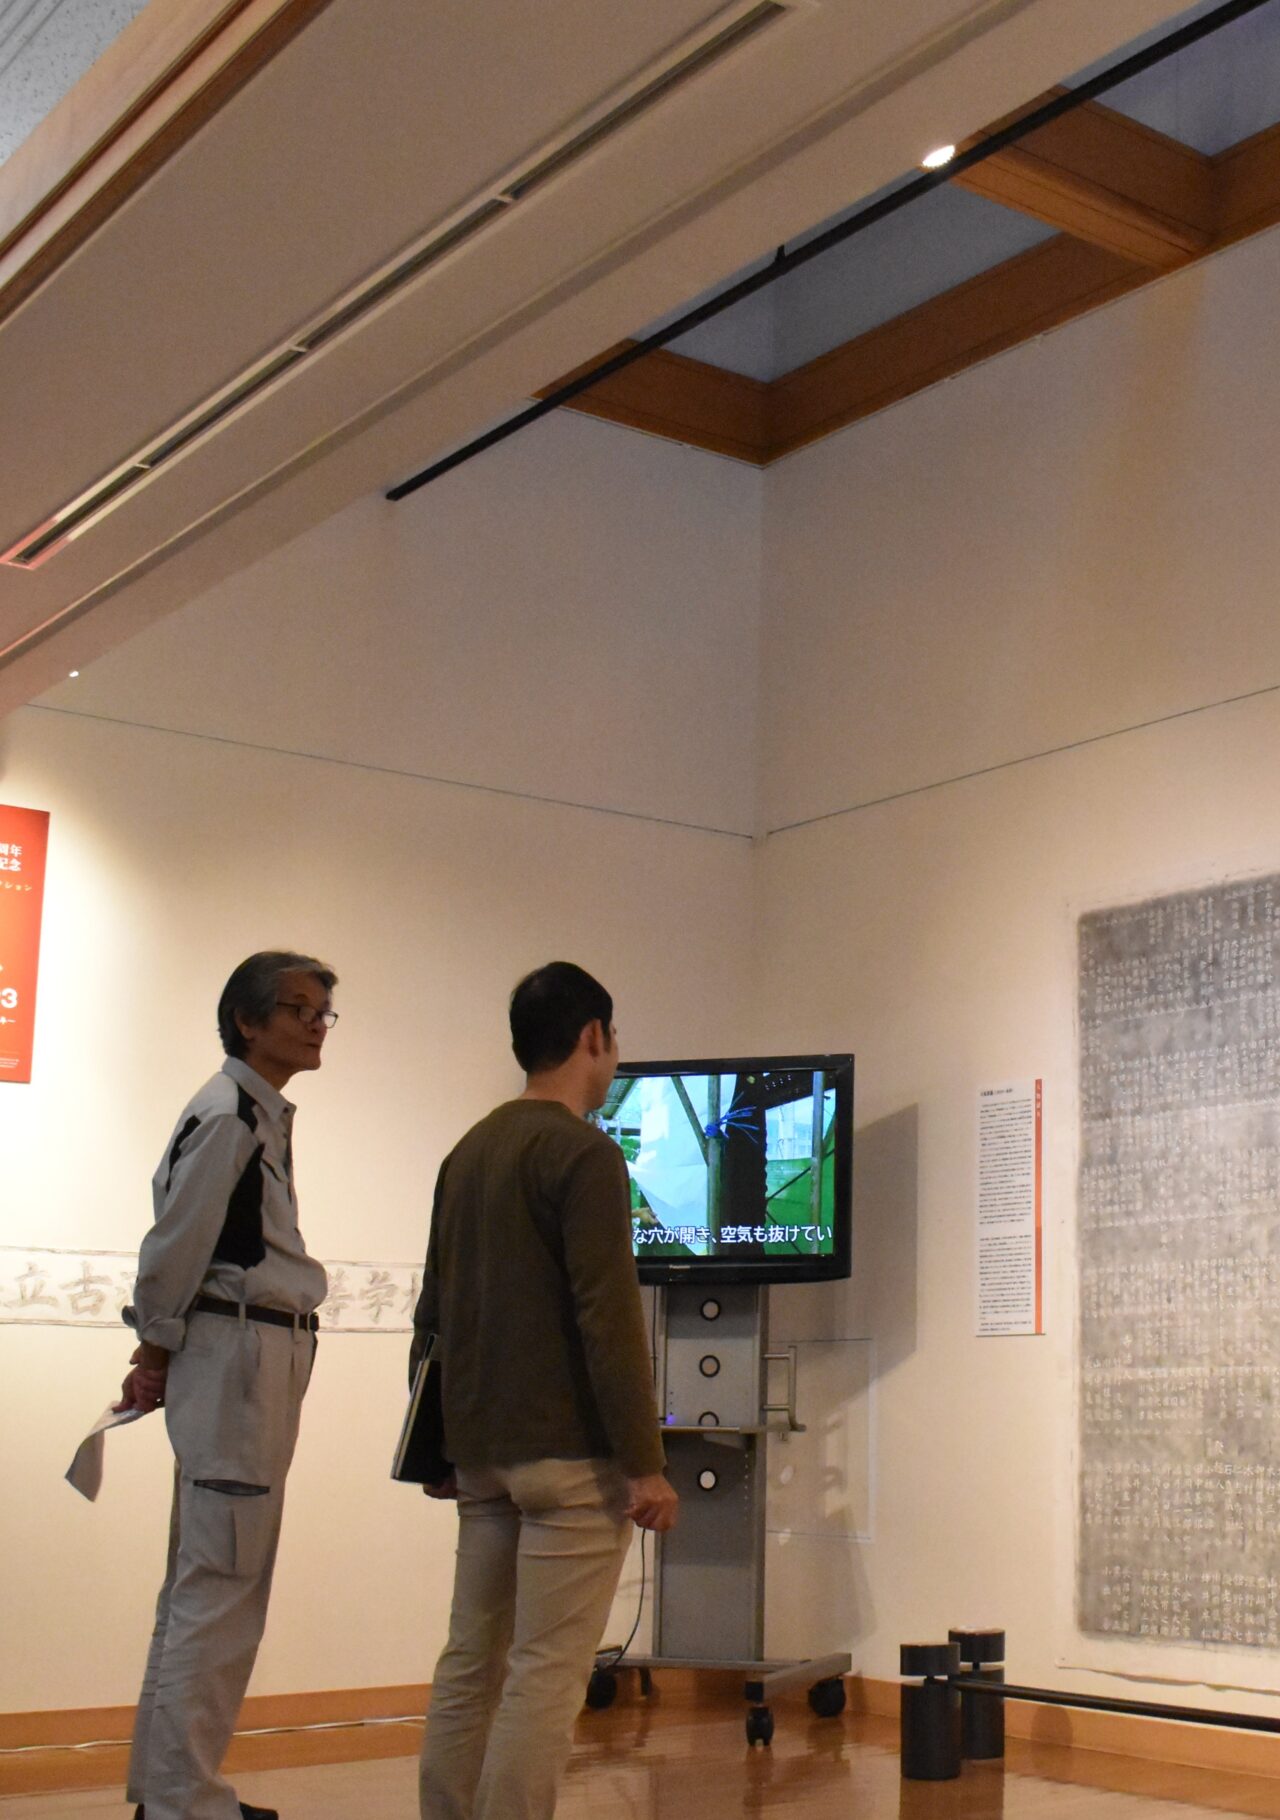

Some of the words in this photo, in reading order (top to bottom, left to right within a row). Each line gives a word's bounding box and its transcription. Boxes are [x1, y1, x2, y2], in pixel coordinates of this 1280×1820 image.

[632, 1225, 833, 1245] な穴が開き、空気も抜けてい
